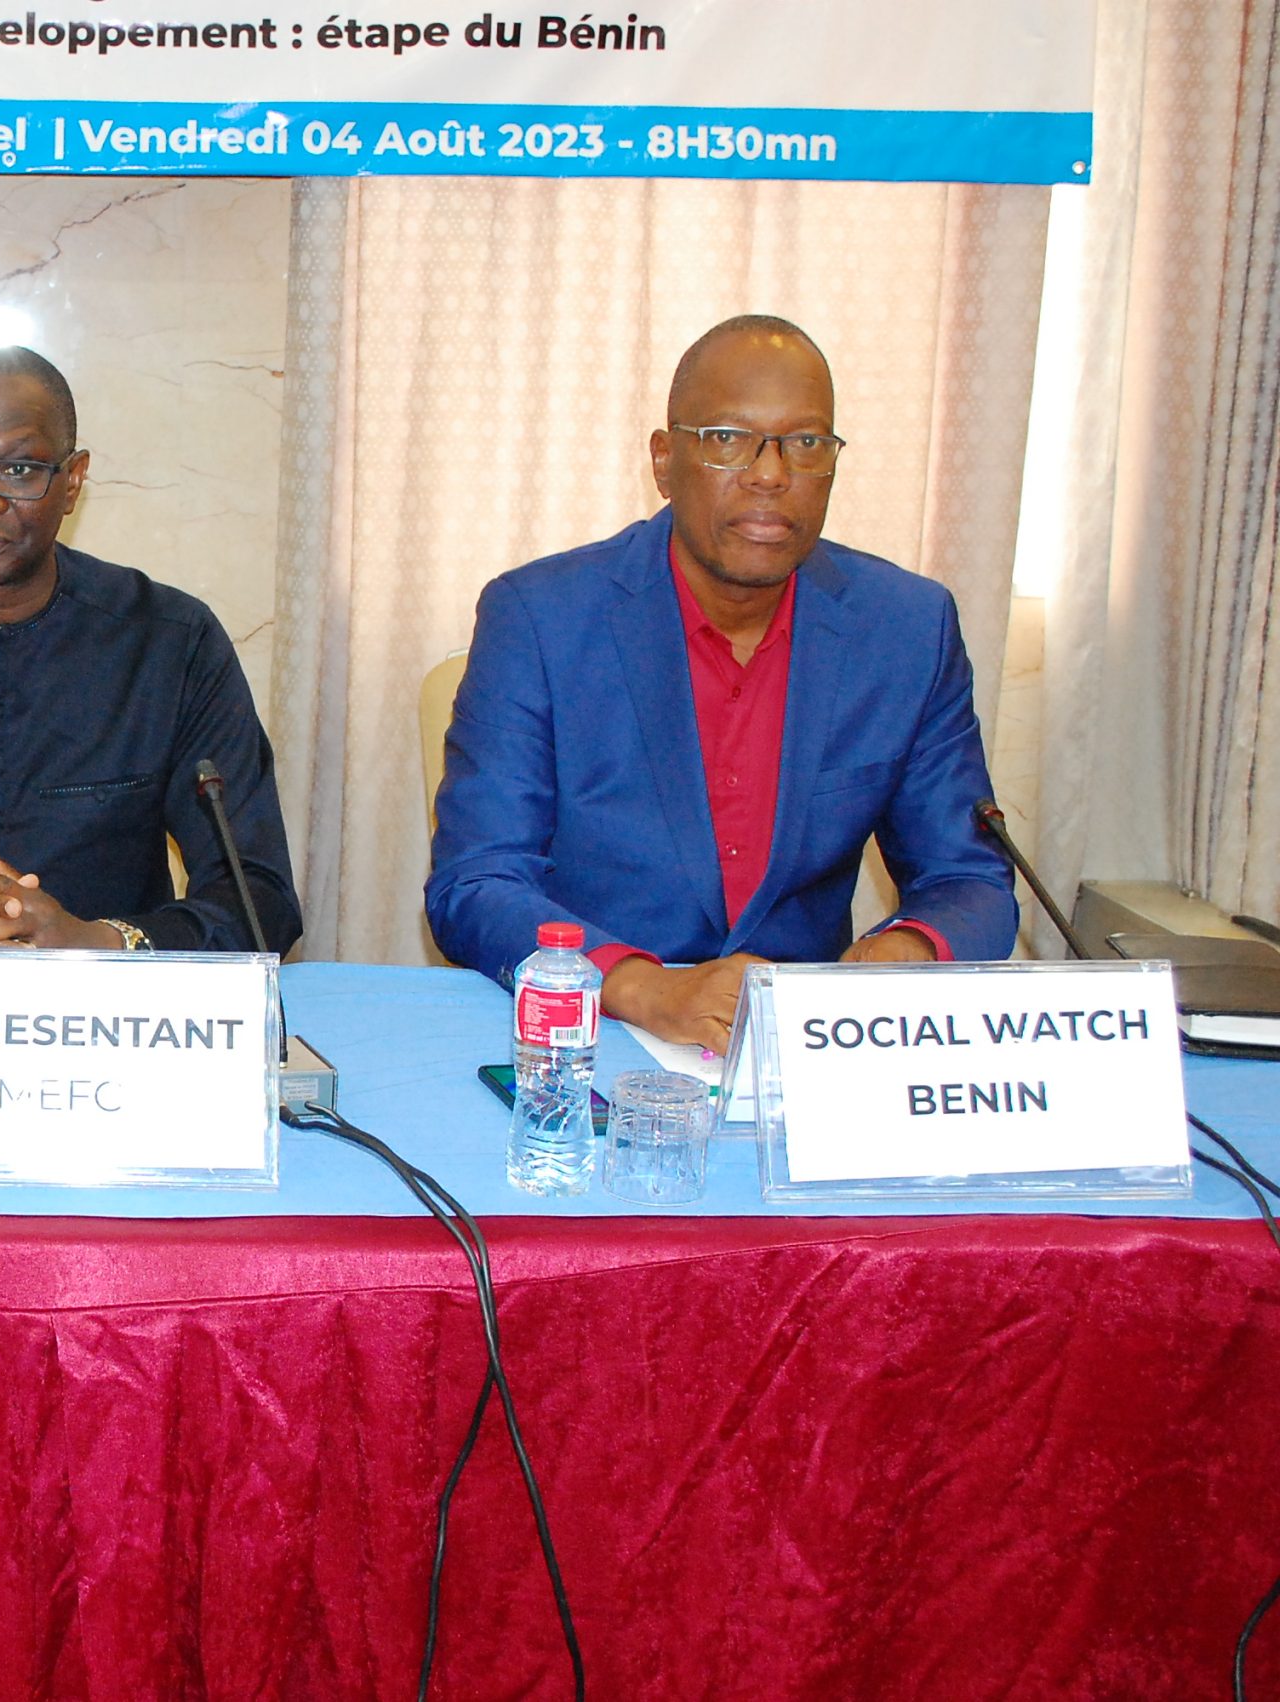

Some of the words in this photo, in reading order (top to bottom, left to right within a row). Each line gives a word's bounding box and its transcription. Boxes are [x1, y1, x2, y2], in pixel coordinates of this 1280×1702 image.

[316, 15, 450, 56] étape
[464, 13, 522, 48] du
[537, 13, 666, 51] Bénin
[79, 118, 289, 155] Vendredi
[302, 121, 362, 155] 04
[373, 121, 486, 157] Août
[498, 123, 605, 159] 2023
[647, 125, 837, 161] 8H30mn
[803, 1015, 971, 1050] SOCIAL
[982, 1009, 1149, 1044] WATCH
[907, 1081, 1048, 1116] BENIN
